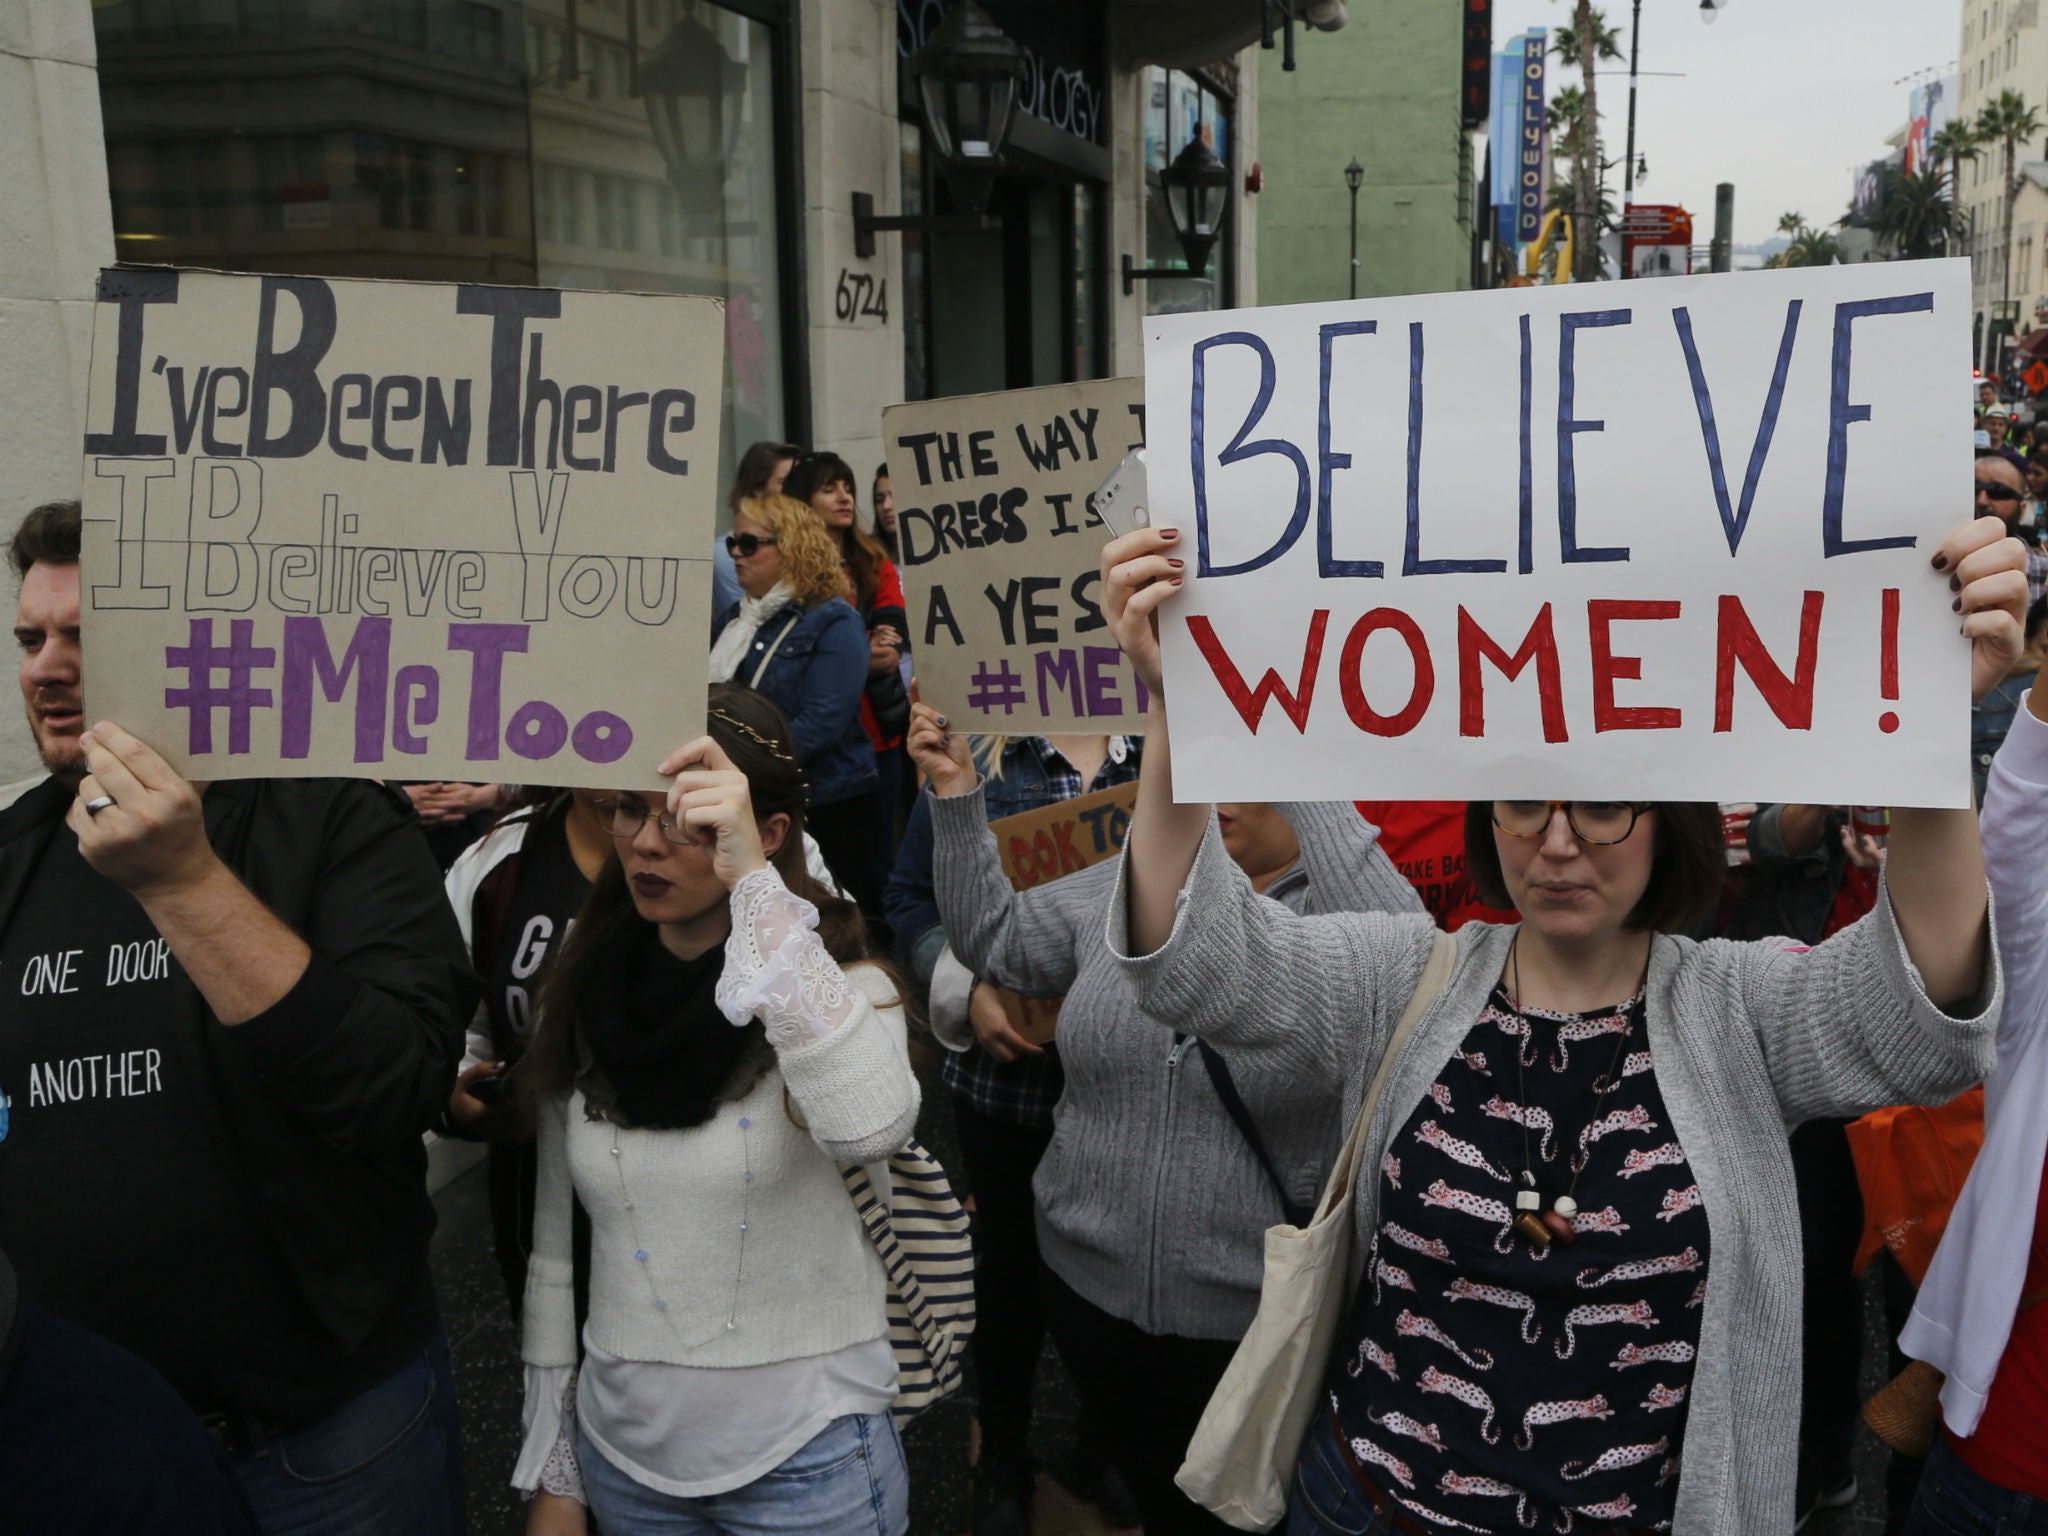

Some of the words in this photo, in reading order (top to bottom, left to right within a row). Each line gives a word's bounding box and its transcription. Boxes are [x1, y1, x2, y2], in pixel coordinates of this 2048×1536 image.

[1522, 42, 1543, 229] HOLLYWOOD
[836, 268, 888, 324] 6724
[84, 269, 250, 457] I've
[456, 284, 696, 476] There
[898, 430, 998, 485] THE
[1015, 408, 1099, 472] WAY
[1191, 292, 1934, 578] BELIEVE
[92, 458, 175, 610] I
[185, 457, 485, 618] Believe
[510, 469, 679, 626] You
[898, 487, 1028, 566] DRESS
[1044, 491, 1105, 537] IS
[925, 585, 965, 646] A
[984, 570, 1108, 645] YES
[1186, 589, 1900, 743] WOMEN!
[1009, 819, 1088, 892] OOK
[21, 949, 83, 995] ONE
[106, 937, 170, 986] DOOR
[30, 1048, 162, 1108] ANOTHER
